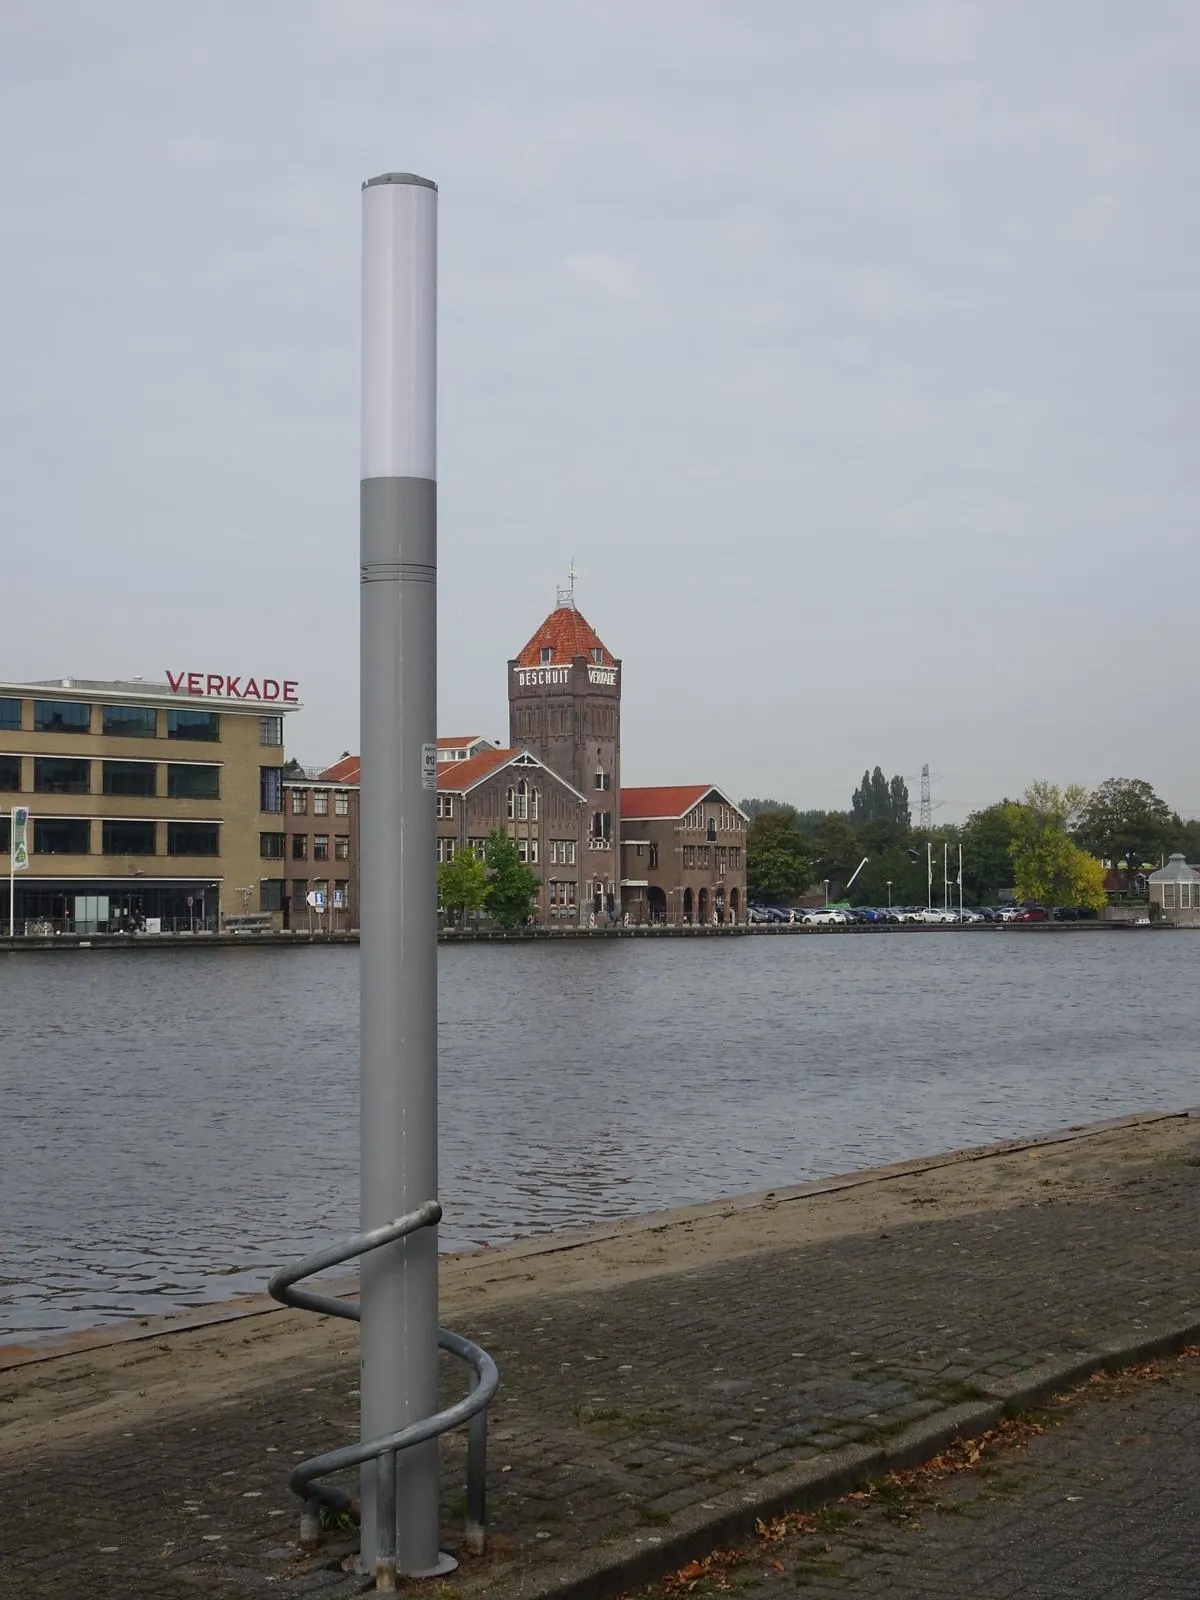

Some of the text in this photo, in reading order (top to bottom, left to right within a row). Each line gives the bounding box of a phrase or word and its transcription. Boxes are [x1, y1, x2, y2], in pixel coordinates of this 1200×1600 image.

[519, 670, 568, 686] BESCHUIT
[588, 670, 616, 685] VERKADE
[165, 670, 299, 702] VERKADE
